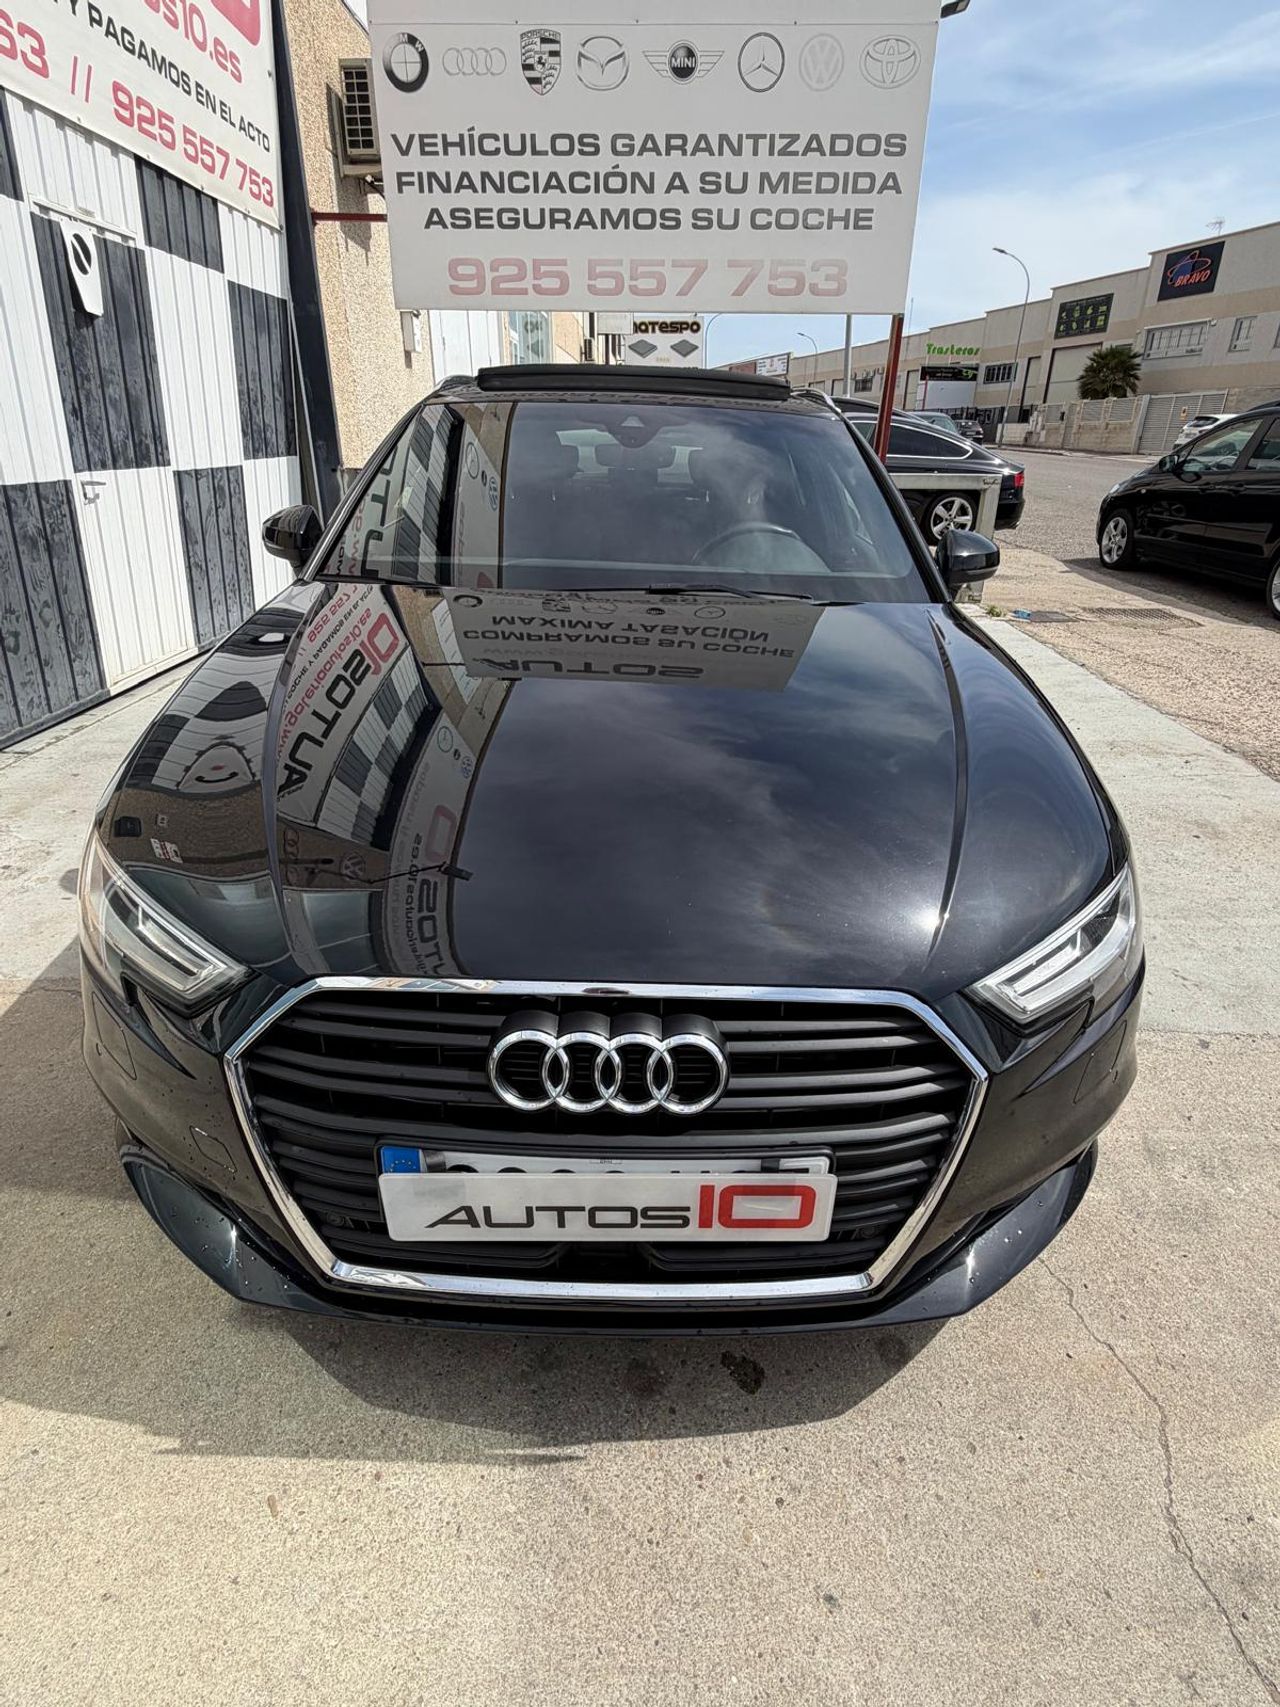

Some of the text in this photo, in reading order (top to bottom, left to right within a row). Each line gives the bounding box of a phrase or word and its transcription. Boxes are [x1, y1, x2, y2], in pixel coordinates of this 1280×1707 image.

[88, 2, 192, 96] PAGAMOS
[195, 80, 217, 115] EN
[219, 99, 236, 128] EL
[238, 115, 270, 152] ACTO
[671, 57, 696, 69] MINI
[112, 80, 176, 151] 925
[182, 124, 230, 180] 557
[235, 158, 274, 208] 753
[390, 125, 908, 157] VEHÍCULOS GARANTIZADOS
[395, 163, 903, 195] FINANCIACIÓN A SU MEDIDA
[423, 207, 875, 231] ASEGURAMOS SU COCHE
[447, 257, 849, 298] 925 557 753
[1174, 269, 1211, 288] BRAVO
[926, 342, 980, 356] Trasteros
[423, 1184, 817, 1229] AUTOS10
